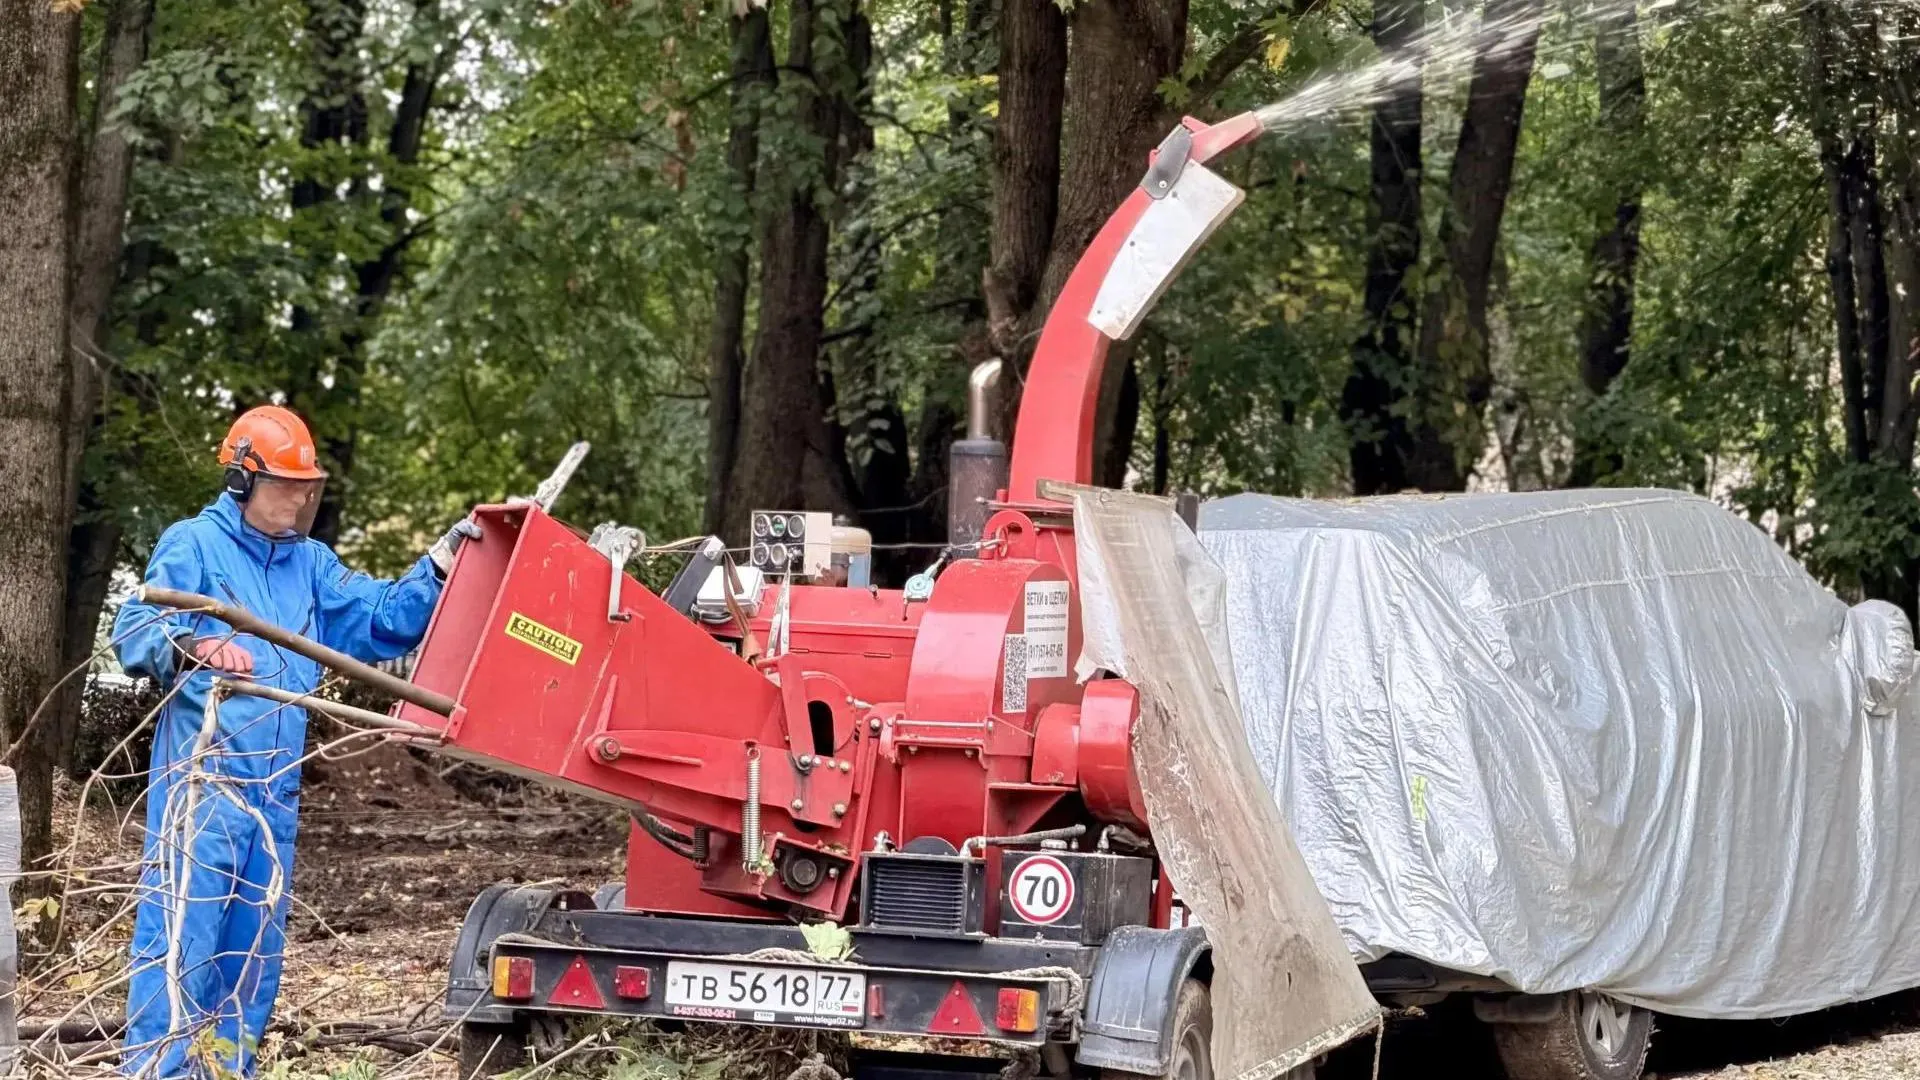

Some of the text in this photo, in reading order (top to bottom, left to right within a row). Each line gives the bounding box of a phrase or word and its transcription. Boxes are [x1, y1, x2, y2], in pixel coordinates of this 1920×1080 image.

[516, 619, 574, 653] CAUTION
[1024, 875, 1060, 908] 70
[681, 970, 852, 1007] ТВ 5618 77
[817, 1000, 841, 1011] RUS
